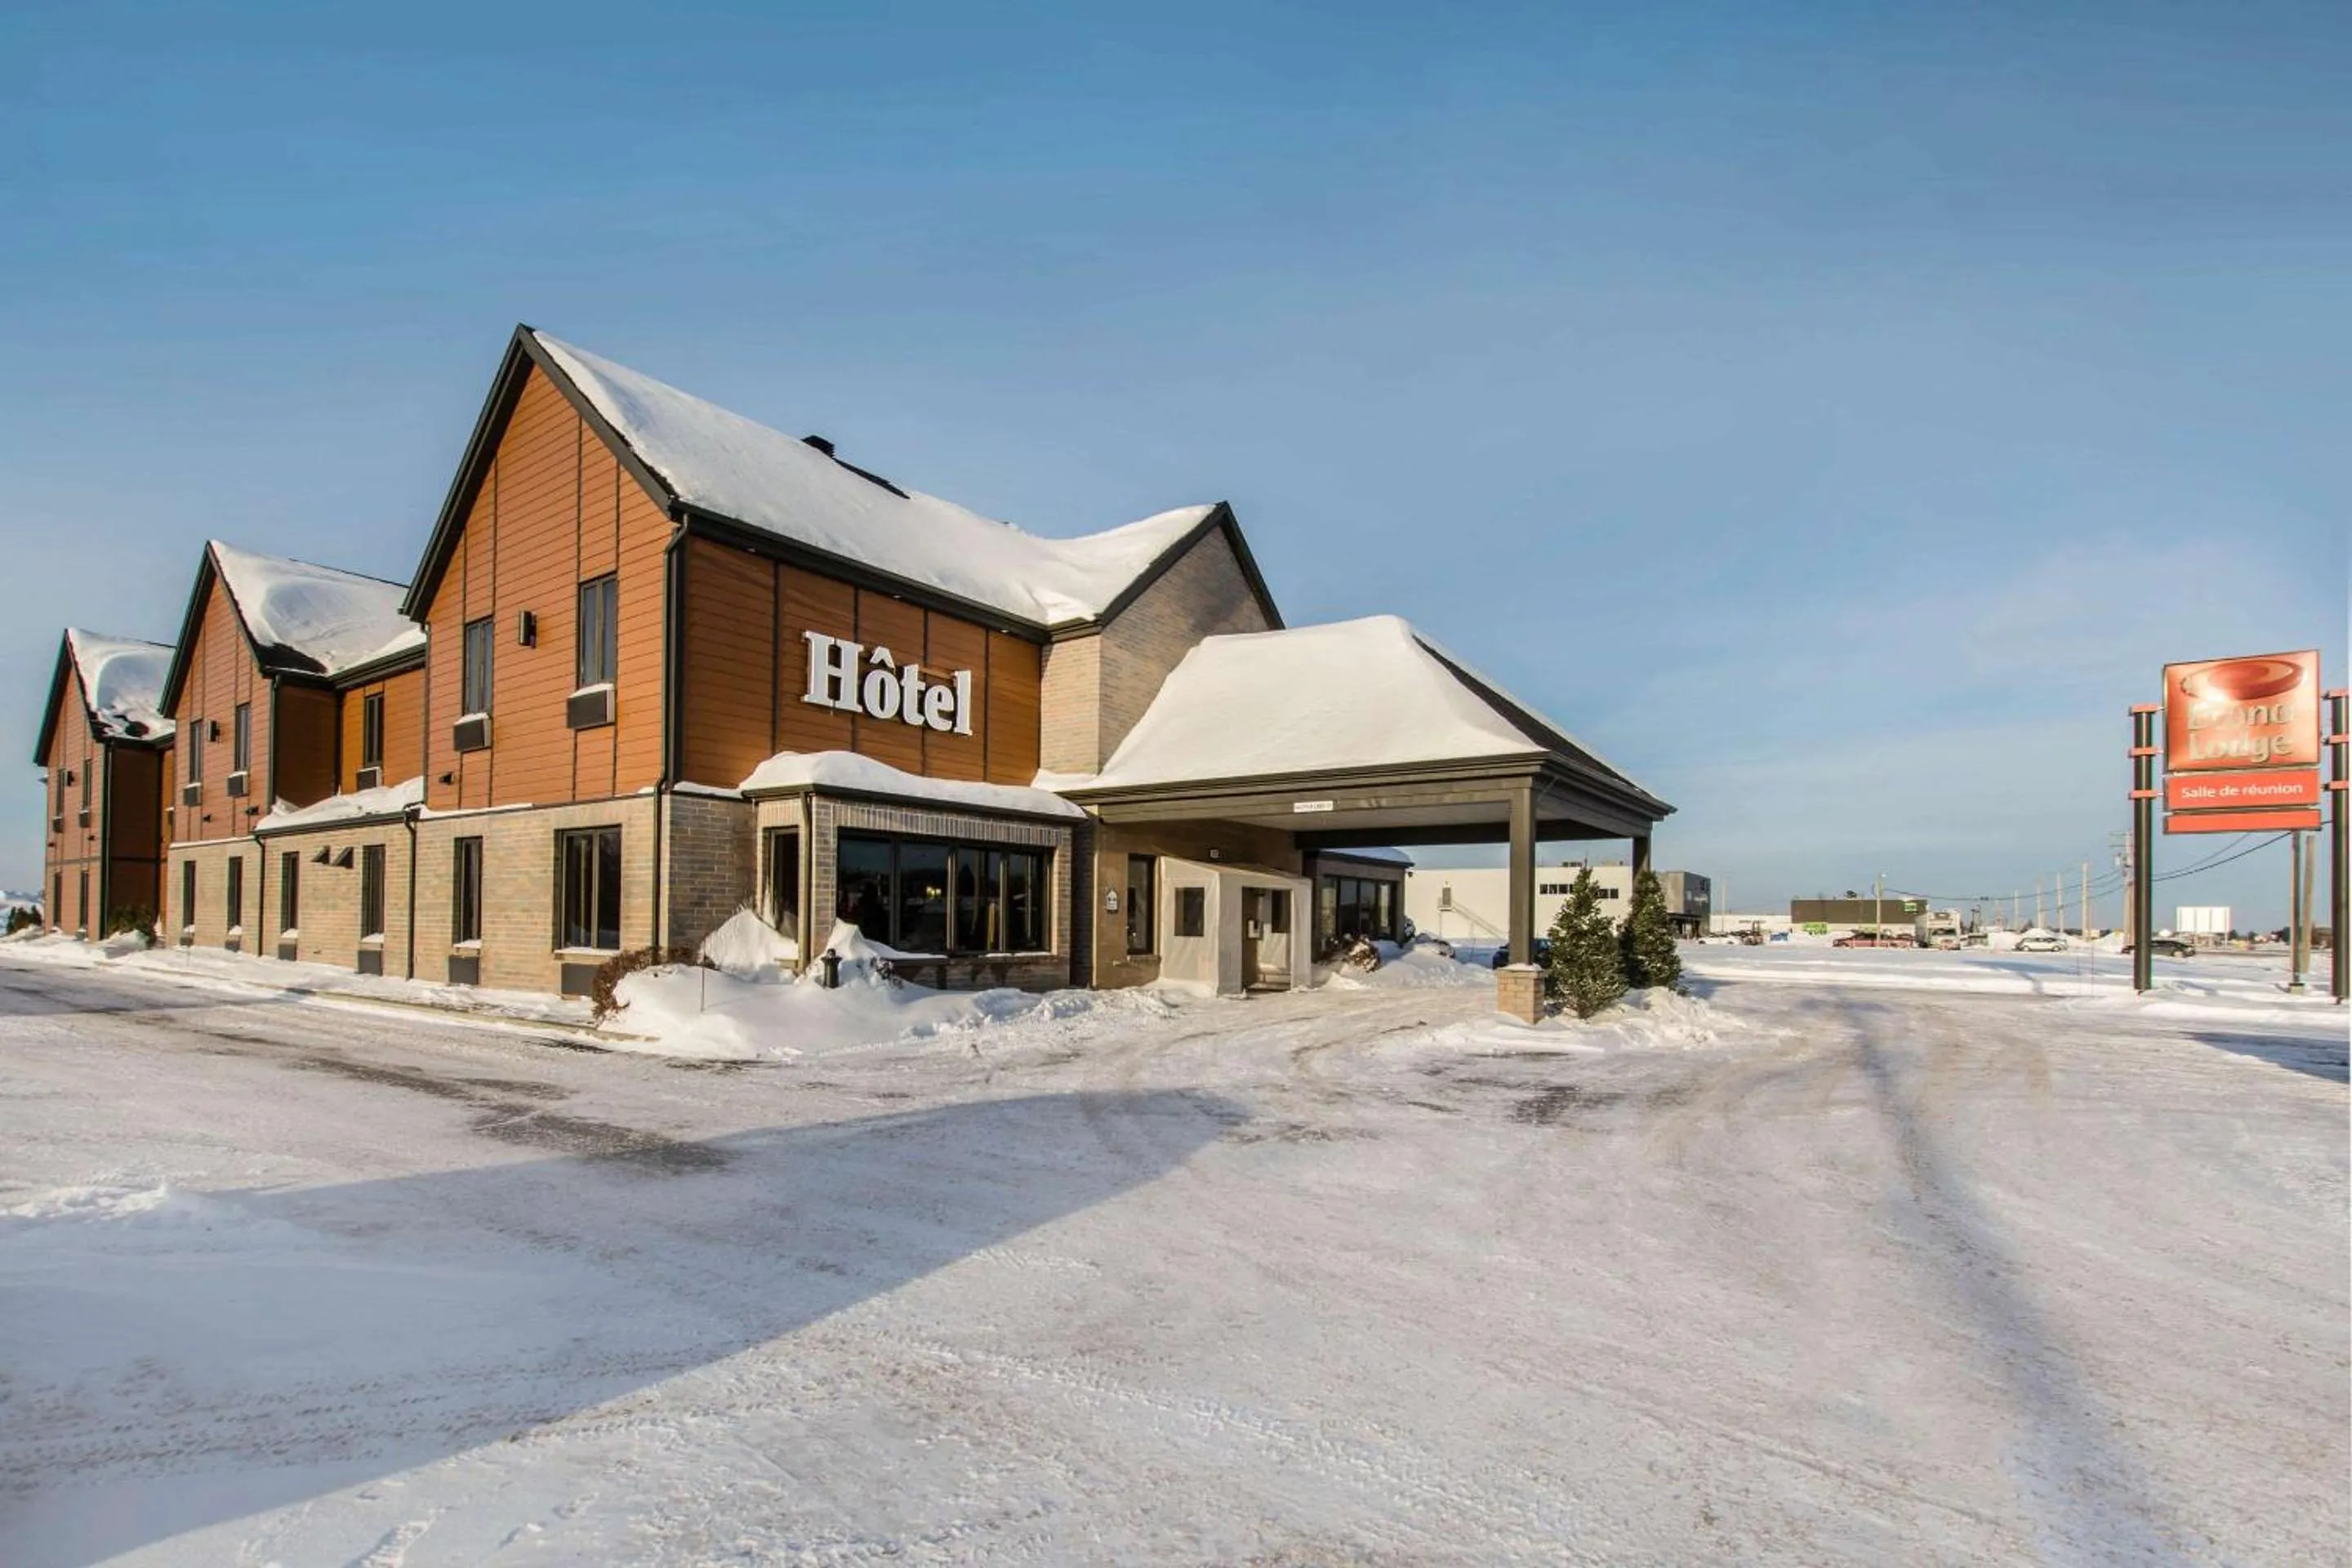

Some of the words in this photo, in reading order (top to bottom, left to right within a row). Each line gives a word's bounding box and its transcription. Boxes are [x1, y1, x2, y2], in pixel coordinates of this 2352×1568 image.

[801, 630, 973, 736] Hôtel
[2189, 733, 2294, 764] Lodge
[2181, 785, 2216, 799] Salle
[2220, 785, 2240, 797] de
[2242, 783, 2304, 796] réunion
